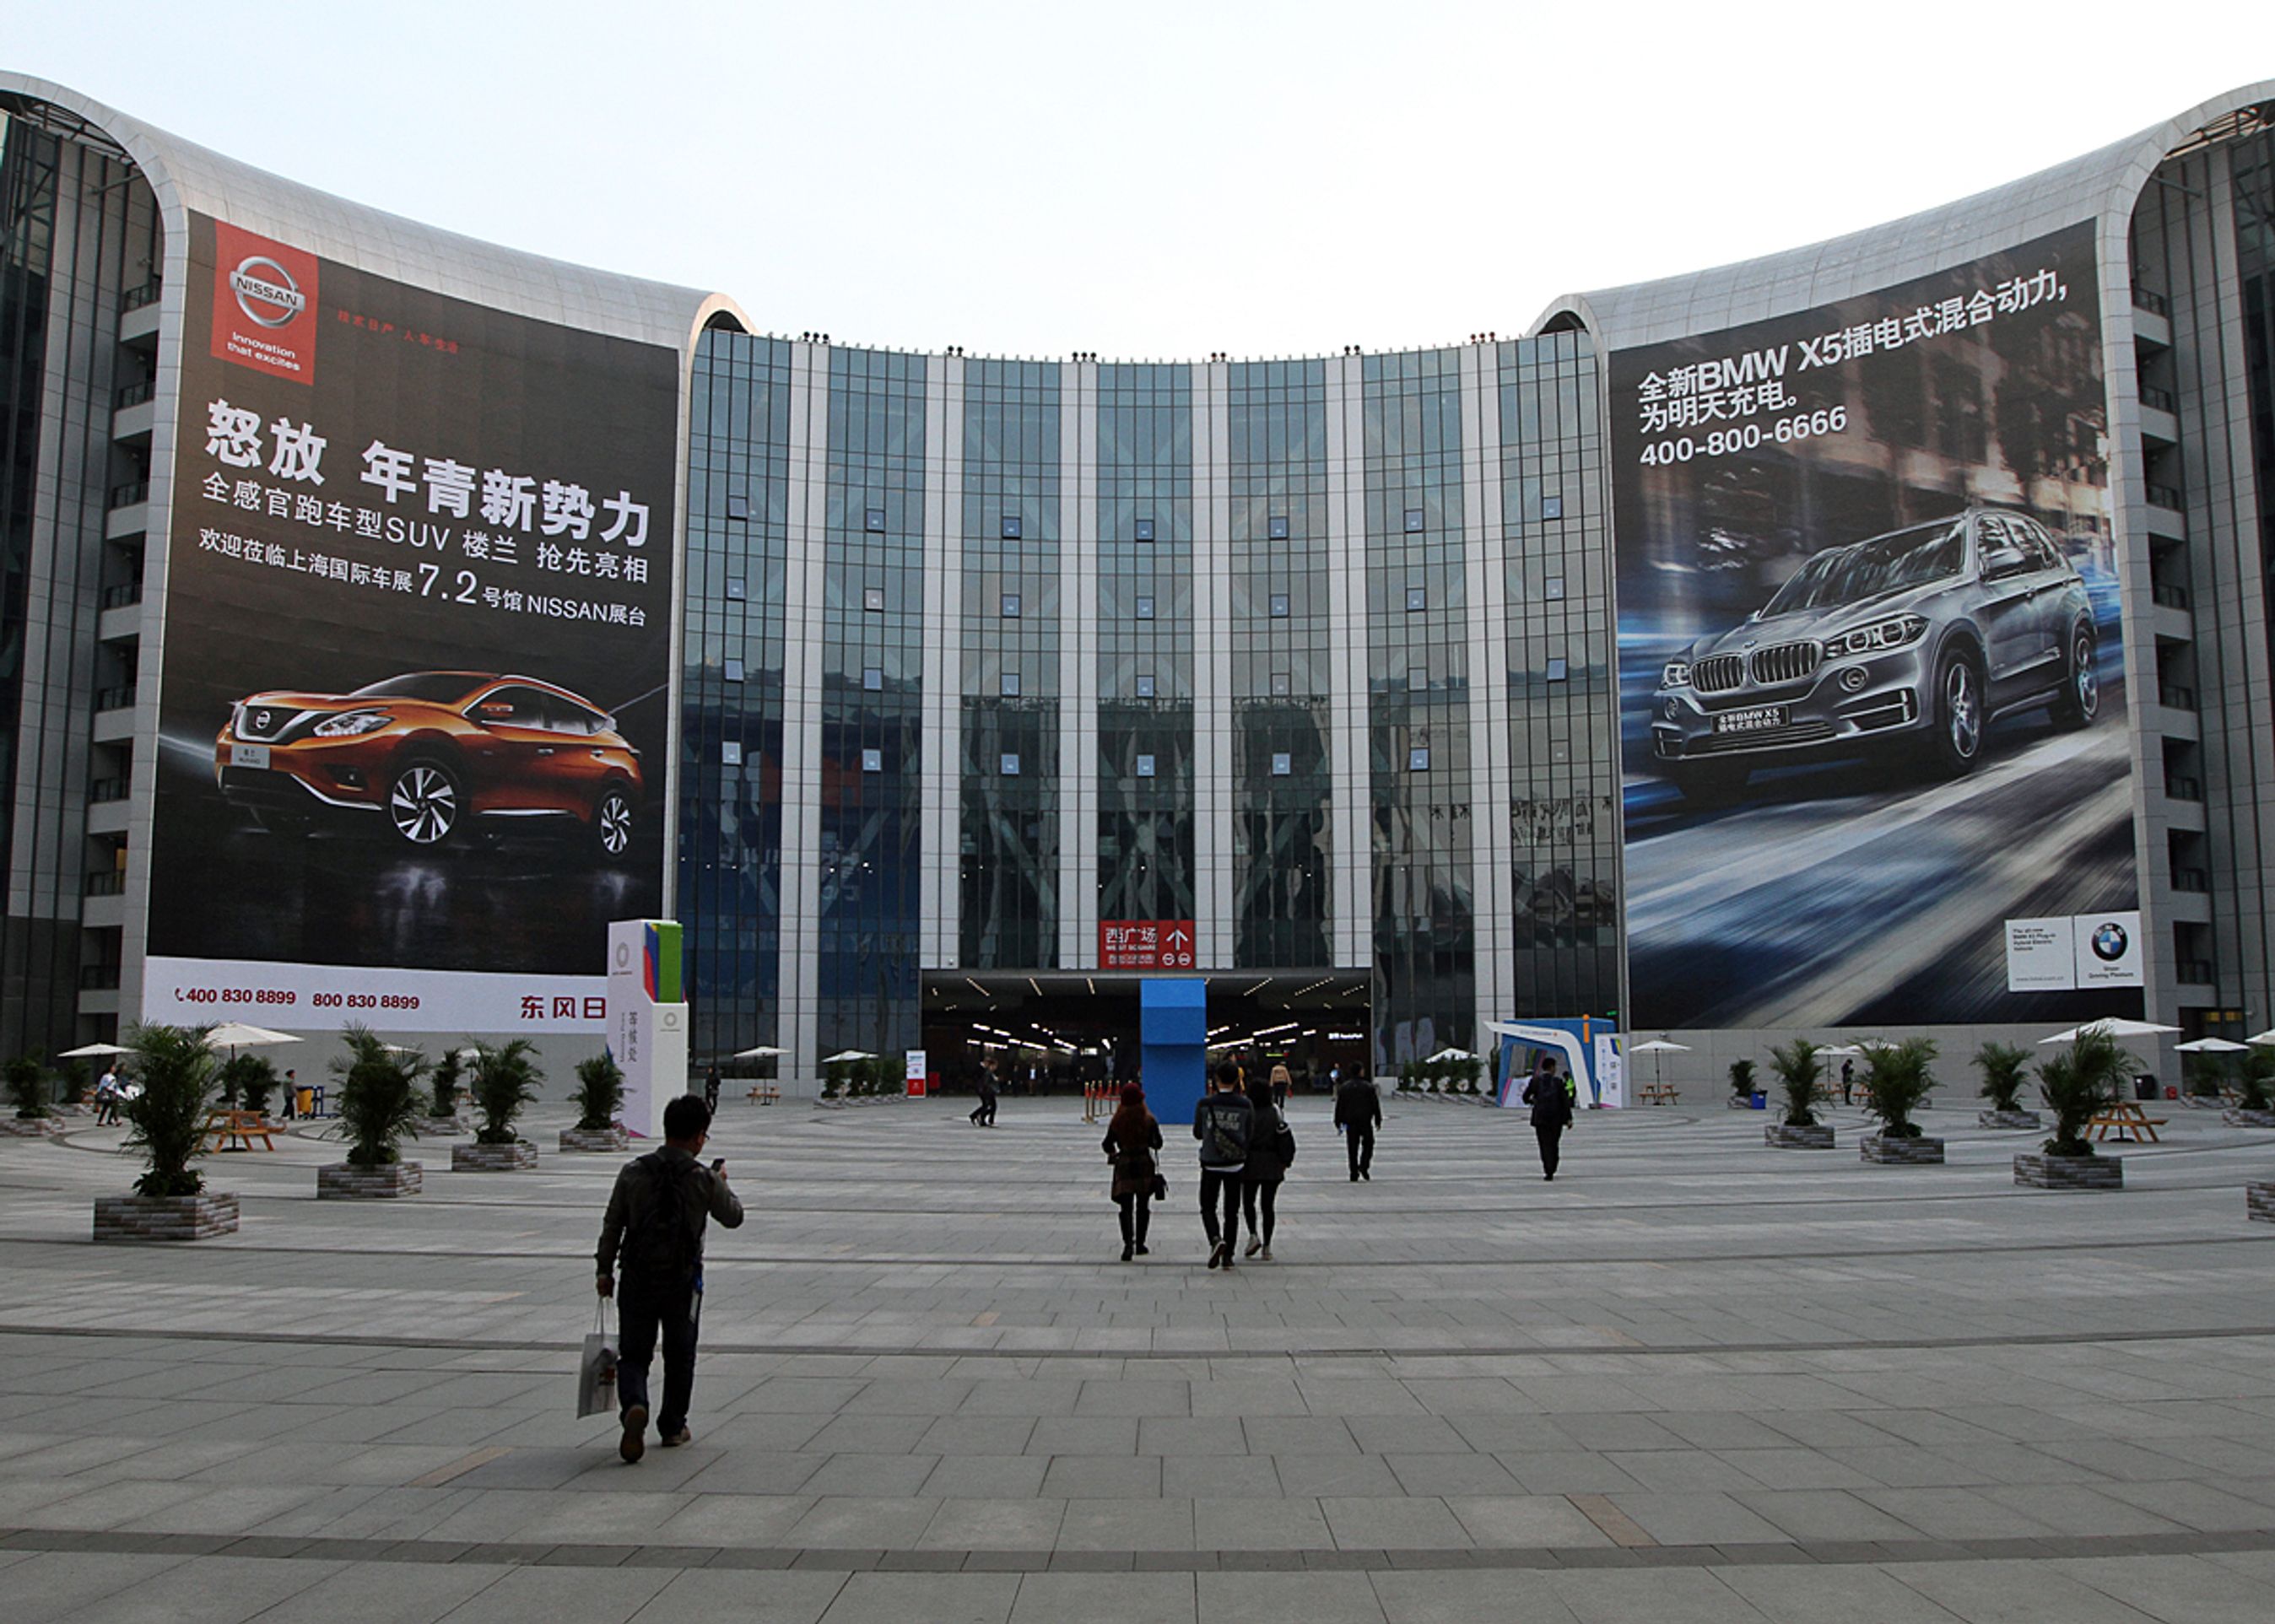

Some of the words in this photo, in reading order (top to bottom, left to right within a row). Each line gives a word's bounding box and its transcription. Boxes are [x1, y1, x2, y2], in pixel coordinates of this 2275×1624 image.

[236, 277, 297, 306] NISSAN
[227, 342, 252, 358] that
[255, 350, 300, 370] excites
[232, 332, 295, 359] Innovation
[1637, 345, 1789, 403] 全新BMW
[1640, 380, 1797, 434] 为明天充电。
[1640, 406, 1847, 466] 400-800-6666
[205, 398, 327, 486] 怒放
[359, 440, 650, 547] 年青新势力
[462, 529, 519, 564] 楼兰
[537, 542, 648, 584] 抢先亮相
[1105, 927, 1158, 943] 西广场
[186, 988, 217, 1003] 400
[221, 989, 252, 1003] 830
[256, 990, 296, 1005] 8899
[312, 993, 343, 1006] 800
[347, 995, 376, 1008] 830
[381, 995, 419, 1009] 8899
[521, 995, 607, 1019] 东风日
